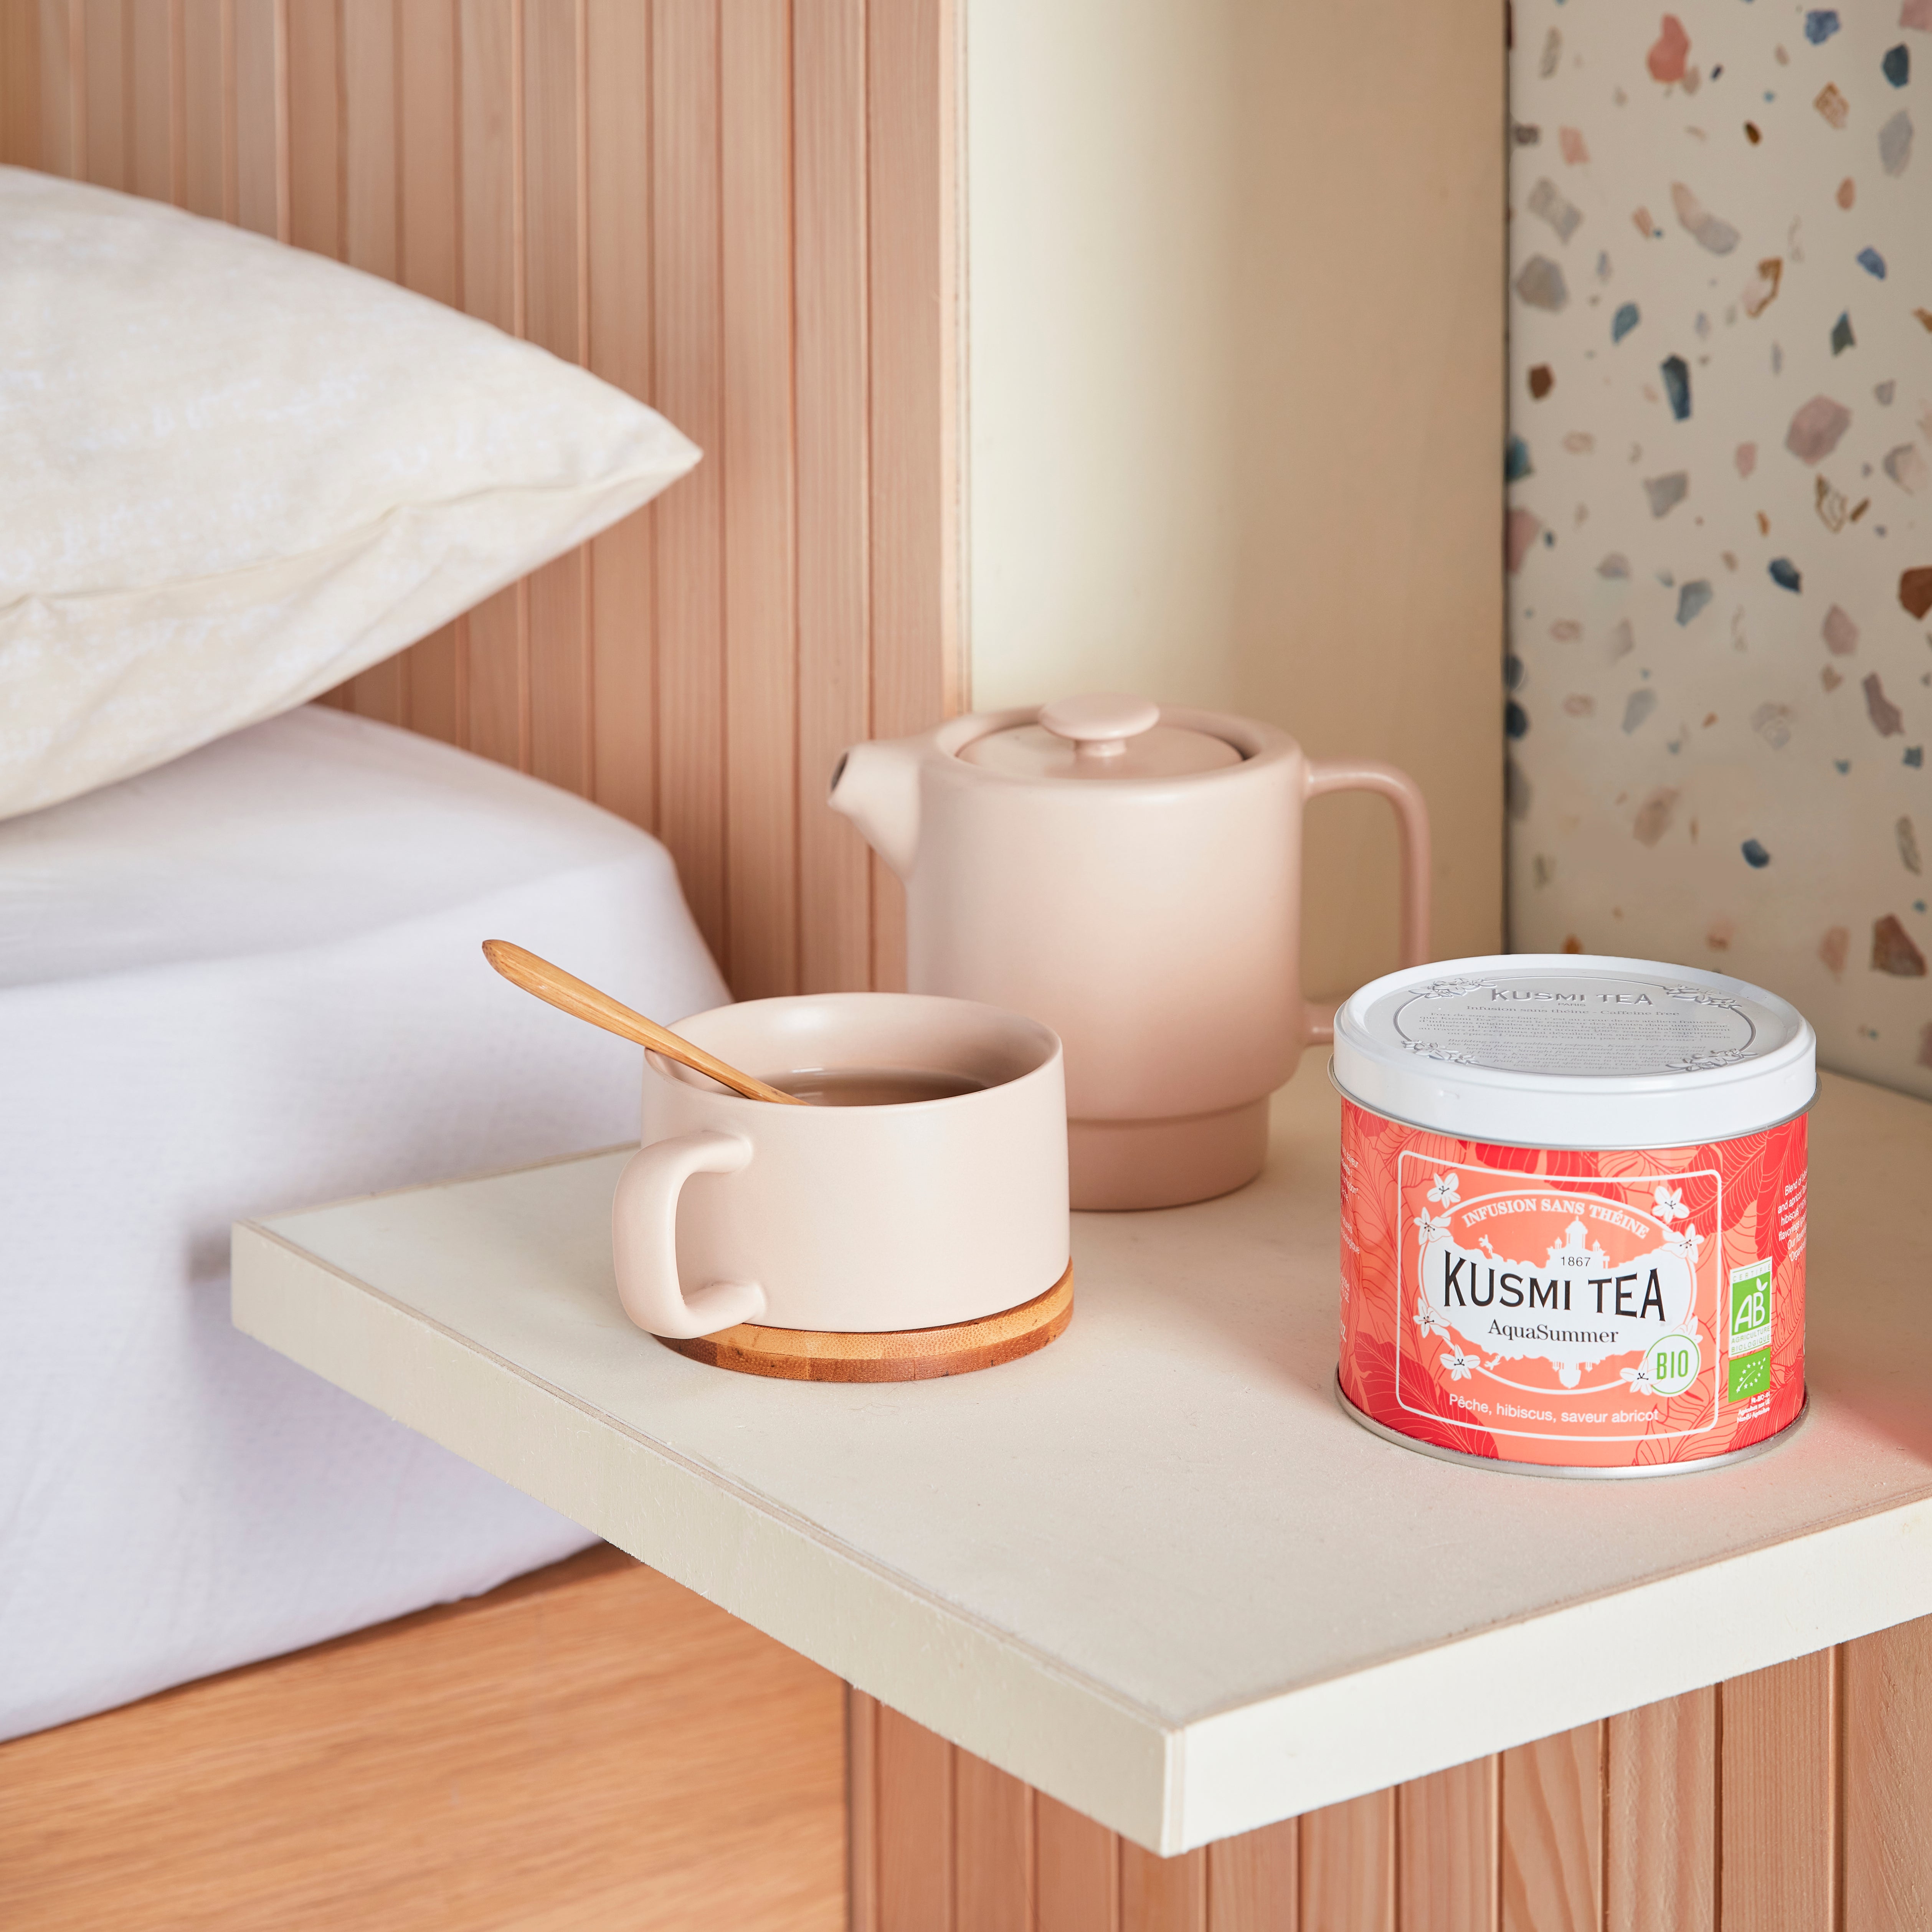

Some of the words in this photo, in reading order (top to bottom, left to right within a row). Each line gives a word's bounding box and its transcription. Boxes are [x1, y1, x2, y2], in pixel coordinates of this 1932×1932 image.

[1492, 988, 1585, 1001] KUSMI
[1597, 994, 1653, 1006] TEA
[1346, 1151, 1359, 1169] saveur
[1785, 1178, 1798, 1196] Blend
[1798, 1174, 1802, 1186] of
[1778, 1199, 1788, 1214] and
[1461, 1198, 1537, 1227] INFUSION
[1541, 1199, 1585, 1215] SANS
[1589, 1207, 1650, 1239] THÉINE
[1779, 1220, 1800, 1242] flavorings
[1788, 1238, 1796, 1250] Our
[1560, 1256, 1591, 1267] 1867
[1443, 1250, 1571, 1311] KUSMI
[1588, 1268, 1666, 1322] TEA
[1734, 1291, 1765, 1333] AB
[1488, 1319, 1619, 1343] AquaSummer
[1731, 1326, 1770, 1344] AGRICULTURE
[1731, 1334, 1770, 1352] BIOLOGIQUE
[1656, 1349, 1688, 1379] BIO
[1449, 1393, 1492, 1416] Pêche,
[1496, 1402, 1556, 1423] hibiscus,
[1561, 1412, 1608, 1423] saveur
[1612, 1409, 1658, 1423] abricot
